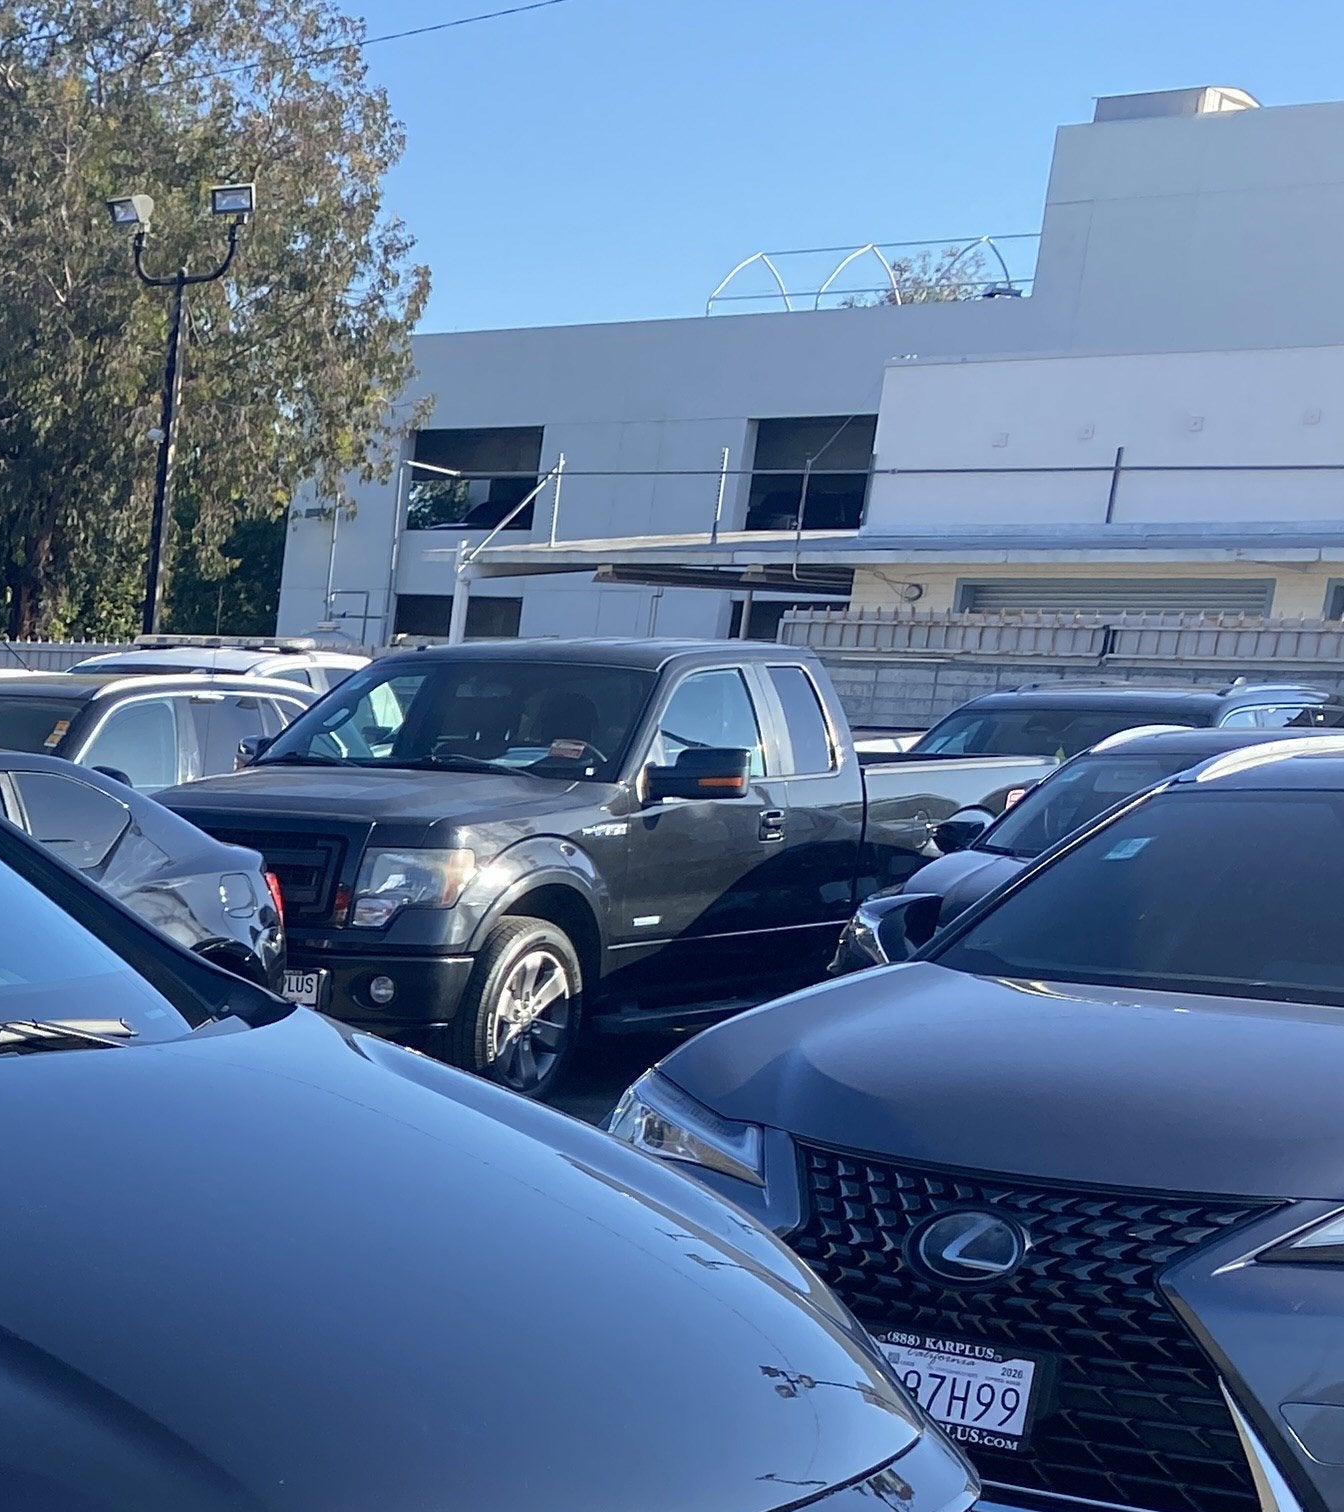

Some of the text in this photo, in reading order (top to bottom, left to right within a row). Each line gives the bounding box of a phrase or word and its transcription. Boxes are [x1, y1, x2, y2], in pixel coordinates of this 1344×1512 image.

[284, 976, 314, 993] LUS
[887, 1331, 996, 1359] (888) KARPLUS
[1000, 1366, 1024, 1380] 2026
[903, 1369, 1021, 1427] 87H99
[940, 1422, 1019, 1452] LUS.COM
